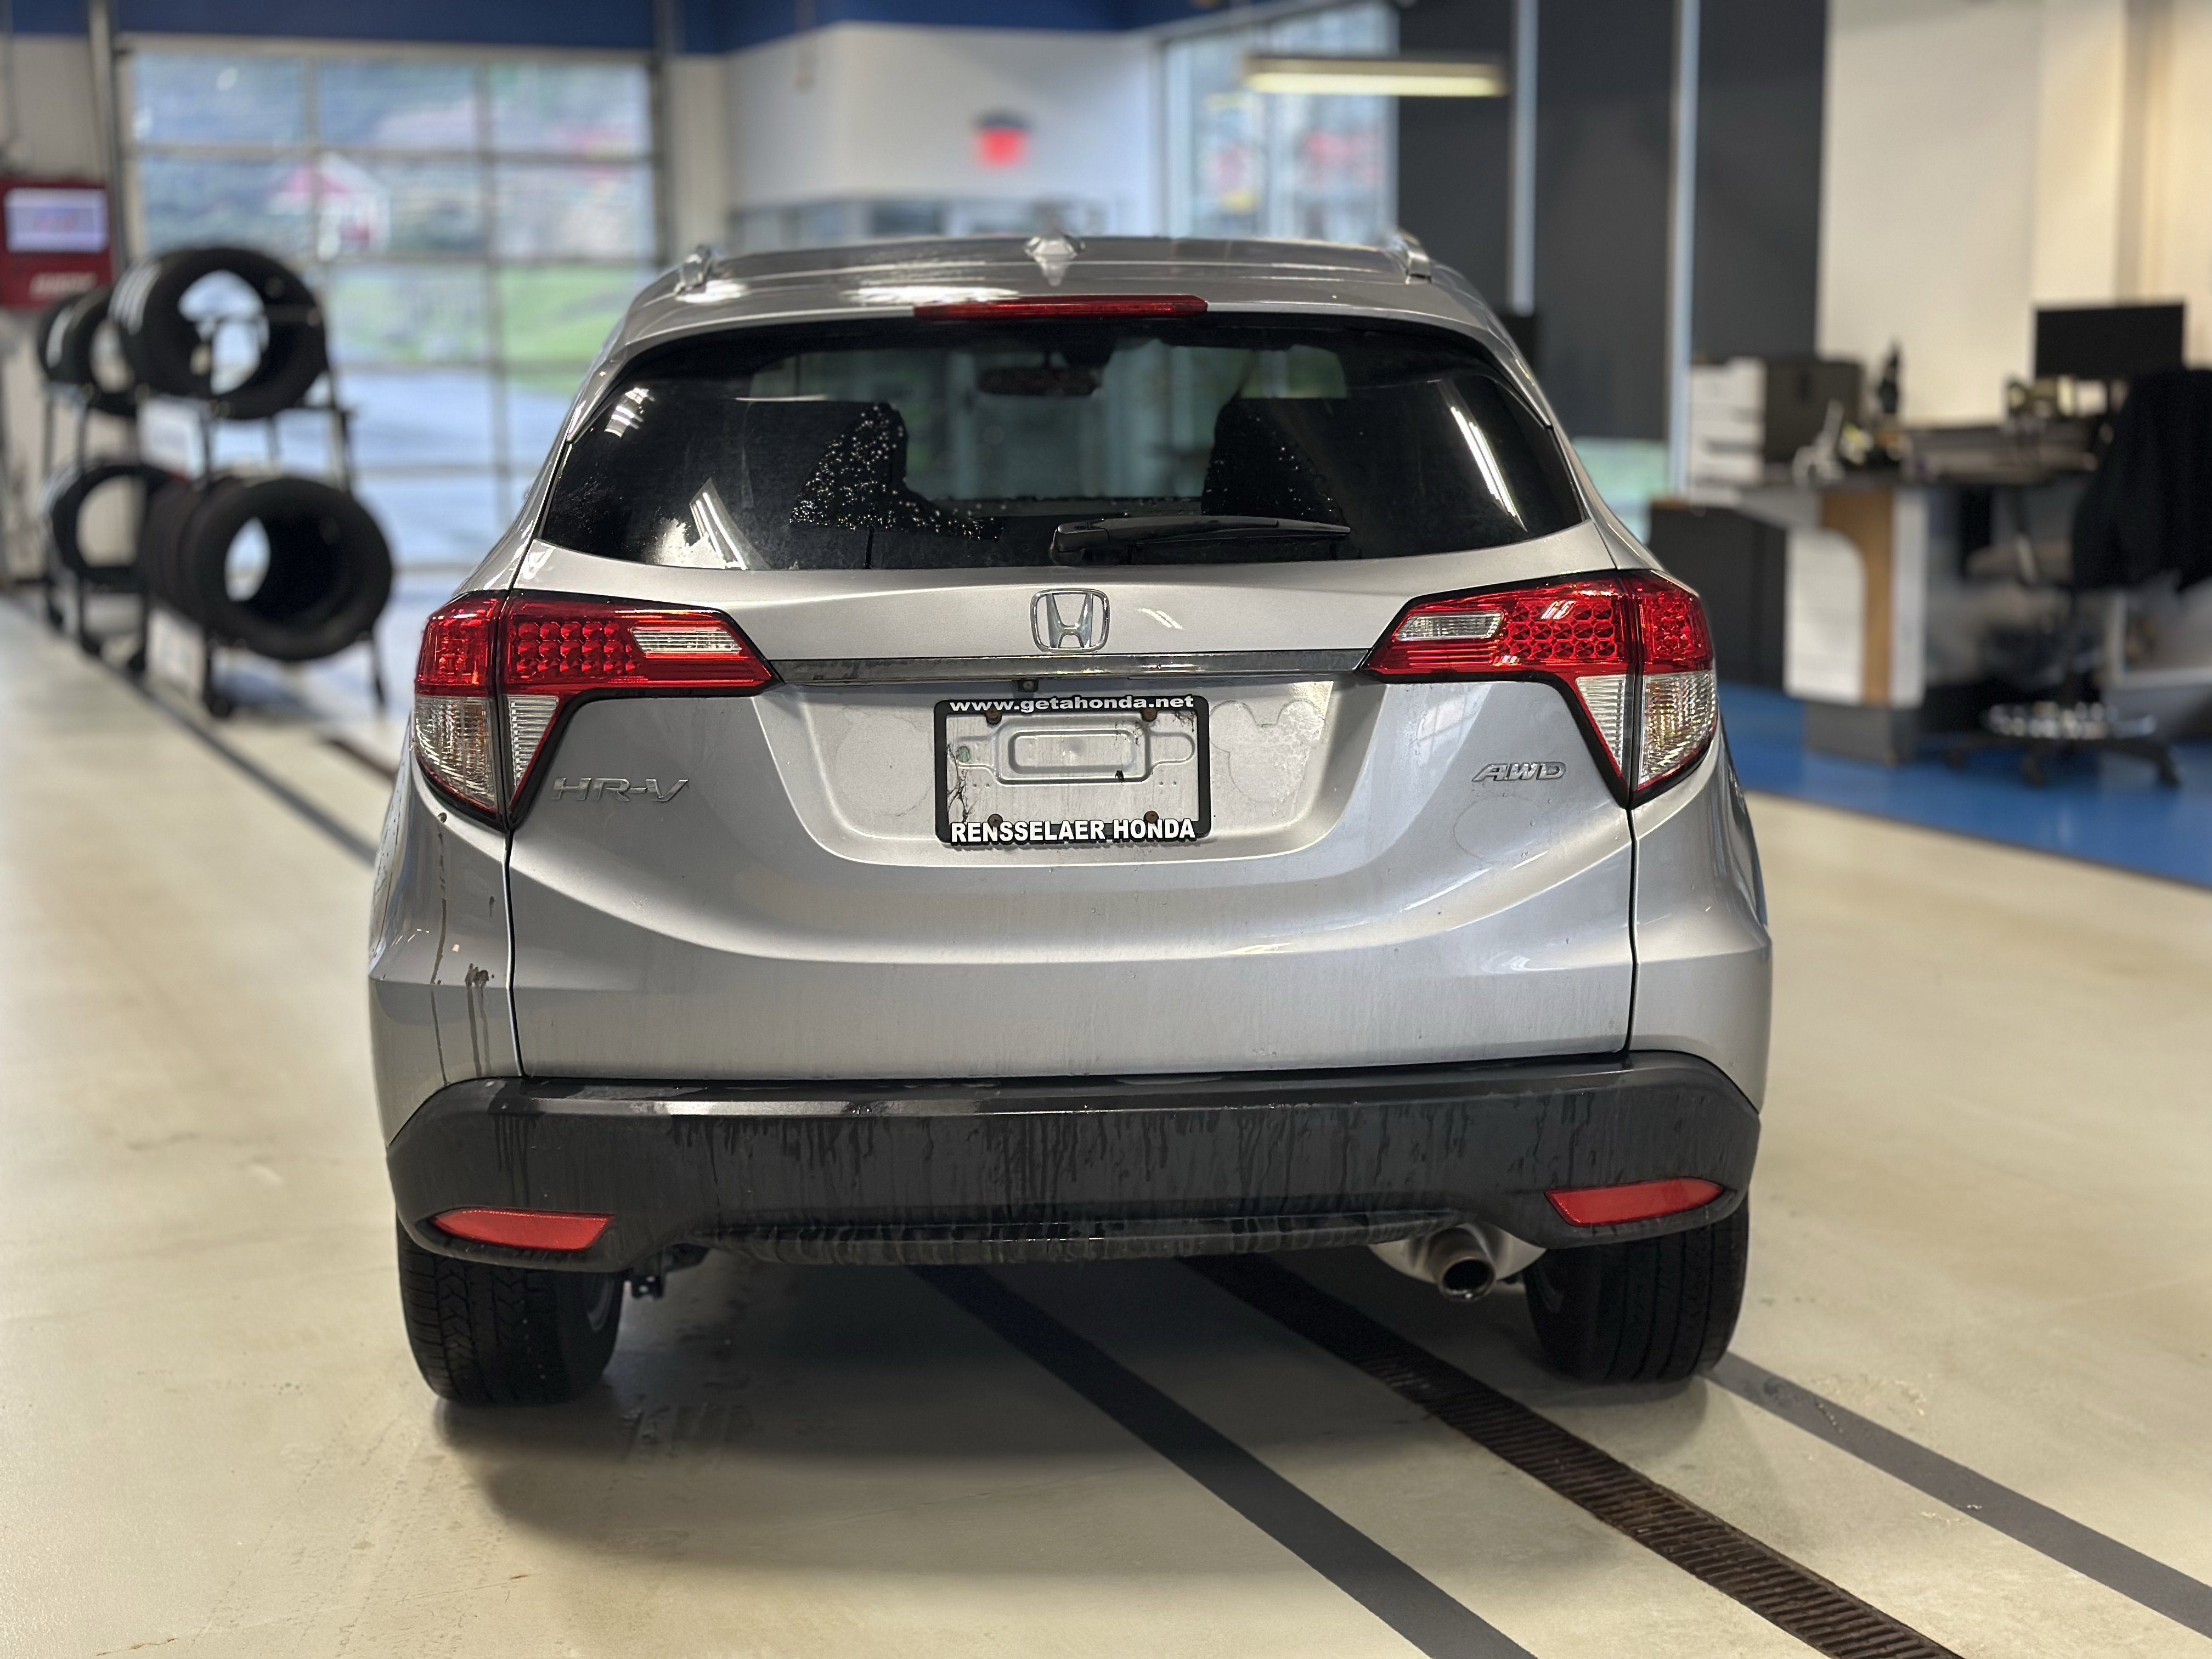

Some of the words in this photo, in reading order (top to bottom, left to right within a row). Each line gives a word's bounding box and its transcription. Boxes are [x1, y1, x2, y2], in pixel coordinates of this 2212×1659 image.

[949, 694, 1194, 713] www.getahonda.net
[1471, 762, 1566, 781] AWD
[551, 777, 688, 802] HR-V
[951, 820, 1105, 843] RENSSELAER
[1113, 819, 1196, 839] HONDA
